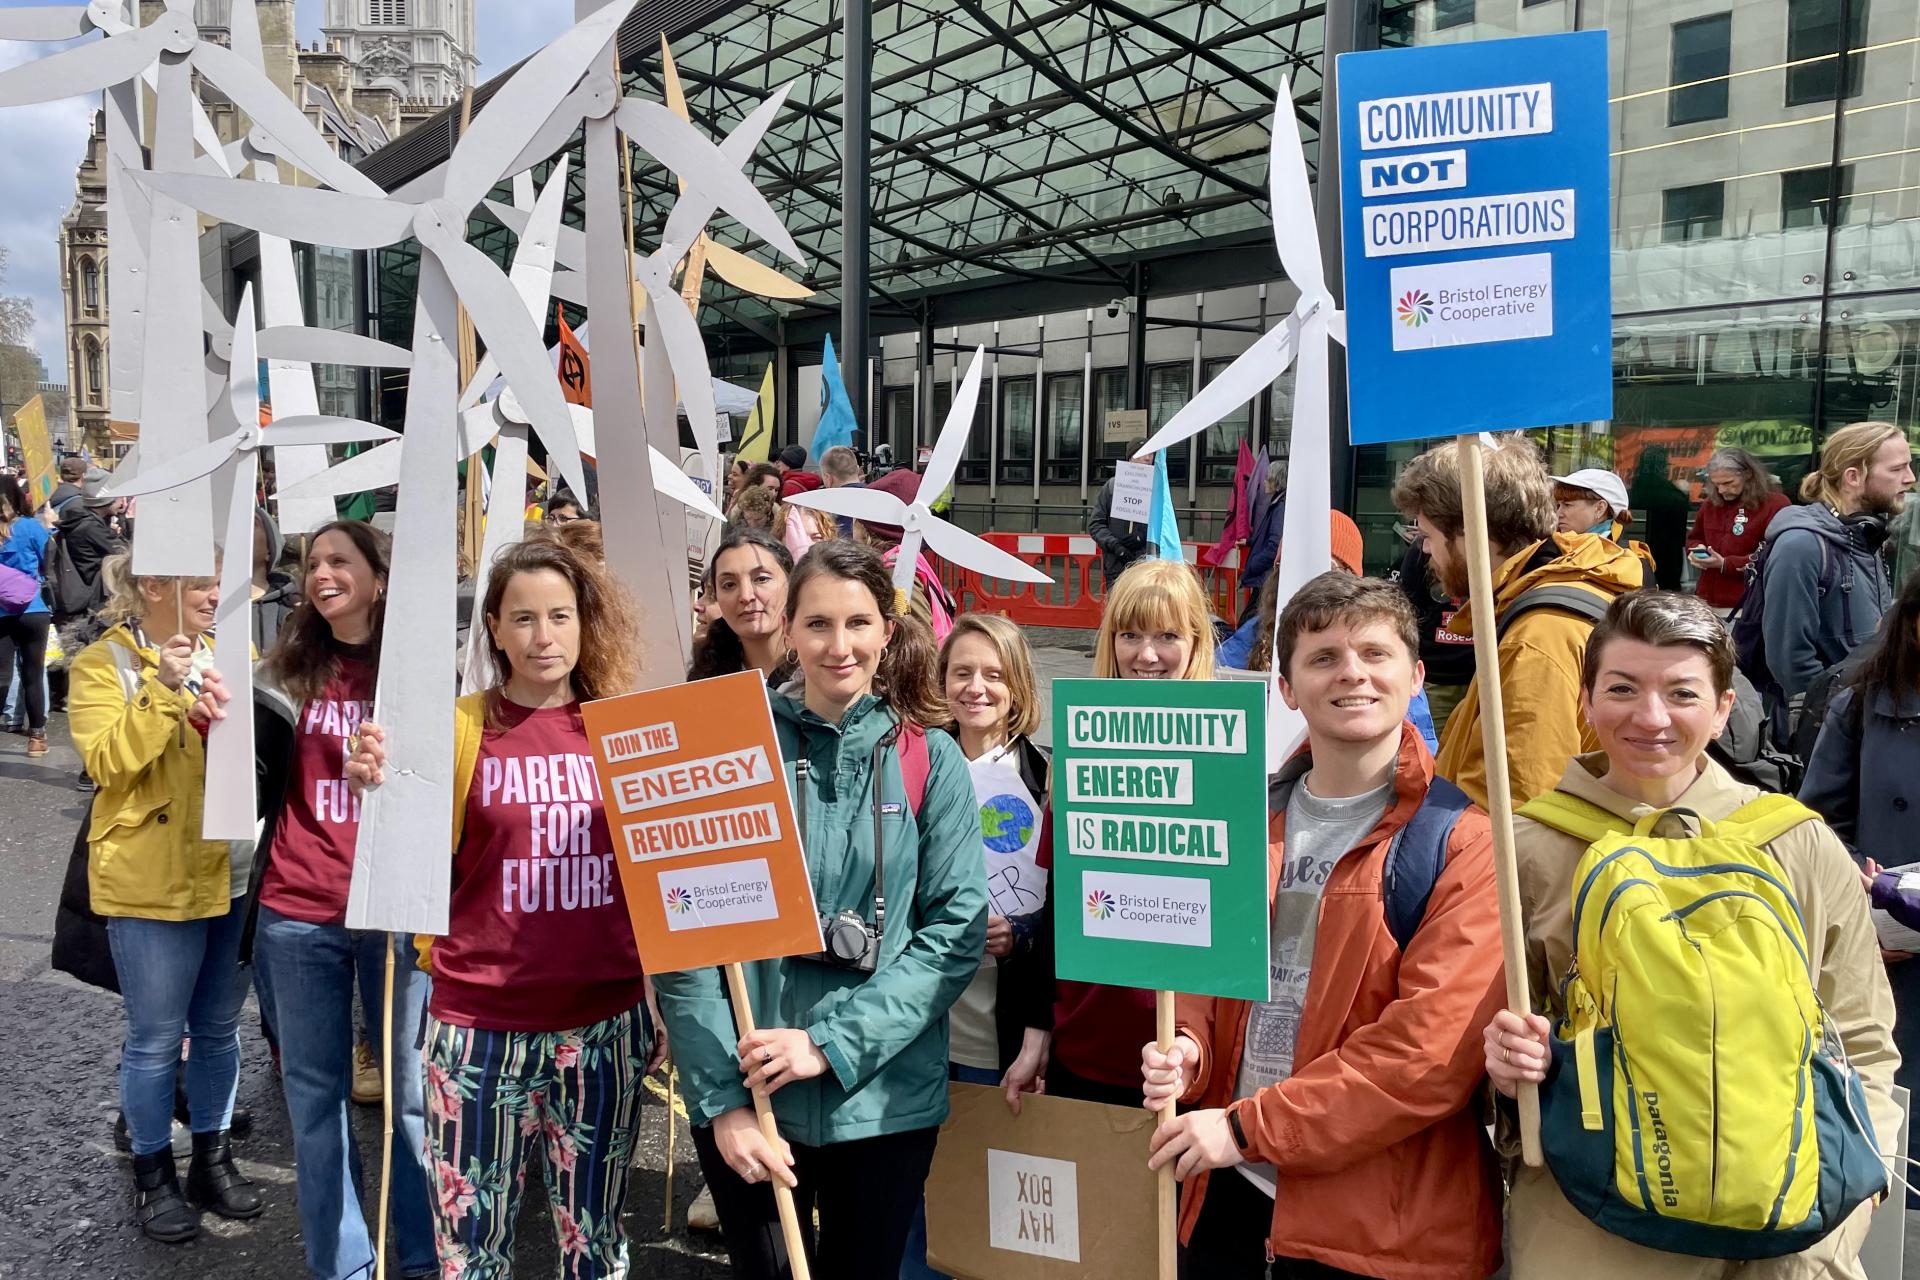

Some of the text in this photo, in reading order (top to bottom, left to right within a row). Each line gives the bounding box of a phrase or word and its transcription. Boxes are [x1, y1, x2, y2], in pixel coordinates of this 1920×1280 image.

[1367, 90, 1540, 143] COMMUNITY
[1371, 158, 1455, 188] NOT
[1372, 199, 1566, 246] CORPORATIONS
[1439, 283, 1547, 304] Bristol Energy
[1440, 300, 1536, 321] Cooperative
[1123, 496, 1143, 505] STOP
[608, 727, 673, 758] JOIN THE
[1074, 710, 1238, 747] COMMUNITY
[620, 754, 757, 805] ENERGY
[1076, 765, 1179, 798] ENERGY
[530, 802, 592, 857] FOR
[630, 809, 772, 855] REVOLUTION
[1076, 817, 1222, 858] IS RADICAL
[503, 853, 614, 913] FUTURE
[693, 880, 768, 897] Bristol Energy
[697, 893, 763, 909] Cooperative
[1119, 894, 1207, 914] Bristol Energy
[1120, 908, 1197, 925] Cooperative
[839, 915, 860, 924] Nikon
[1642, 1091, 1679, 1207] patagonia
[1016, 1170, 1053, 1207] BOX
[1018, 1208, 1055, 1245] HAY
